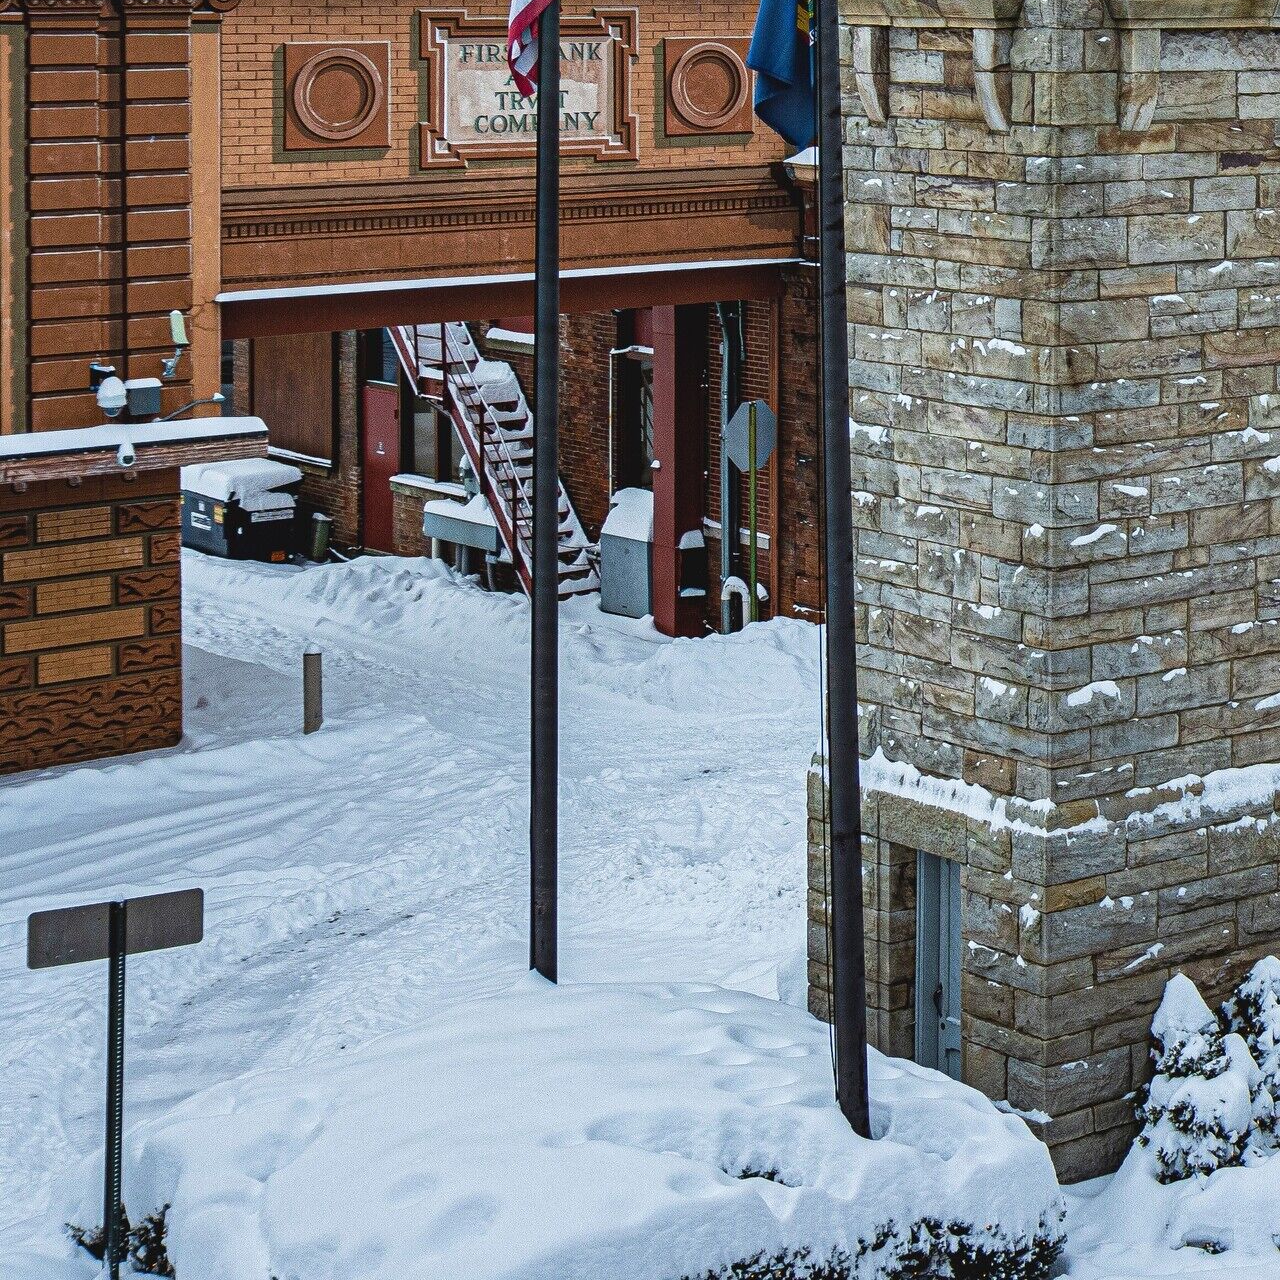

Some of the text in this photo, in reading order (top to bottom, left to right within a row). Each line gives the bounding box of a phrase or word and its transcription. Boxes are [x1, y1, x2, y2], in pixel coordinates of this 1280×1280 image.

[459, 44, 509, 63] FIRS
[495, 90, 568, 111] TRVT
[474, 111, 601, 133] COMNY
